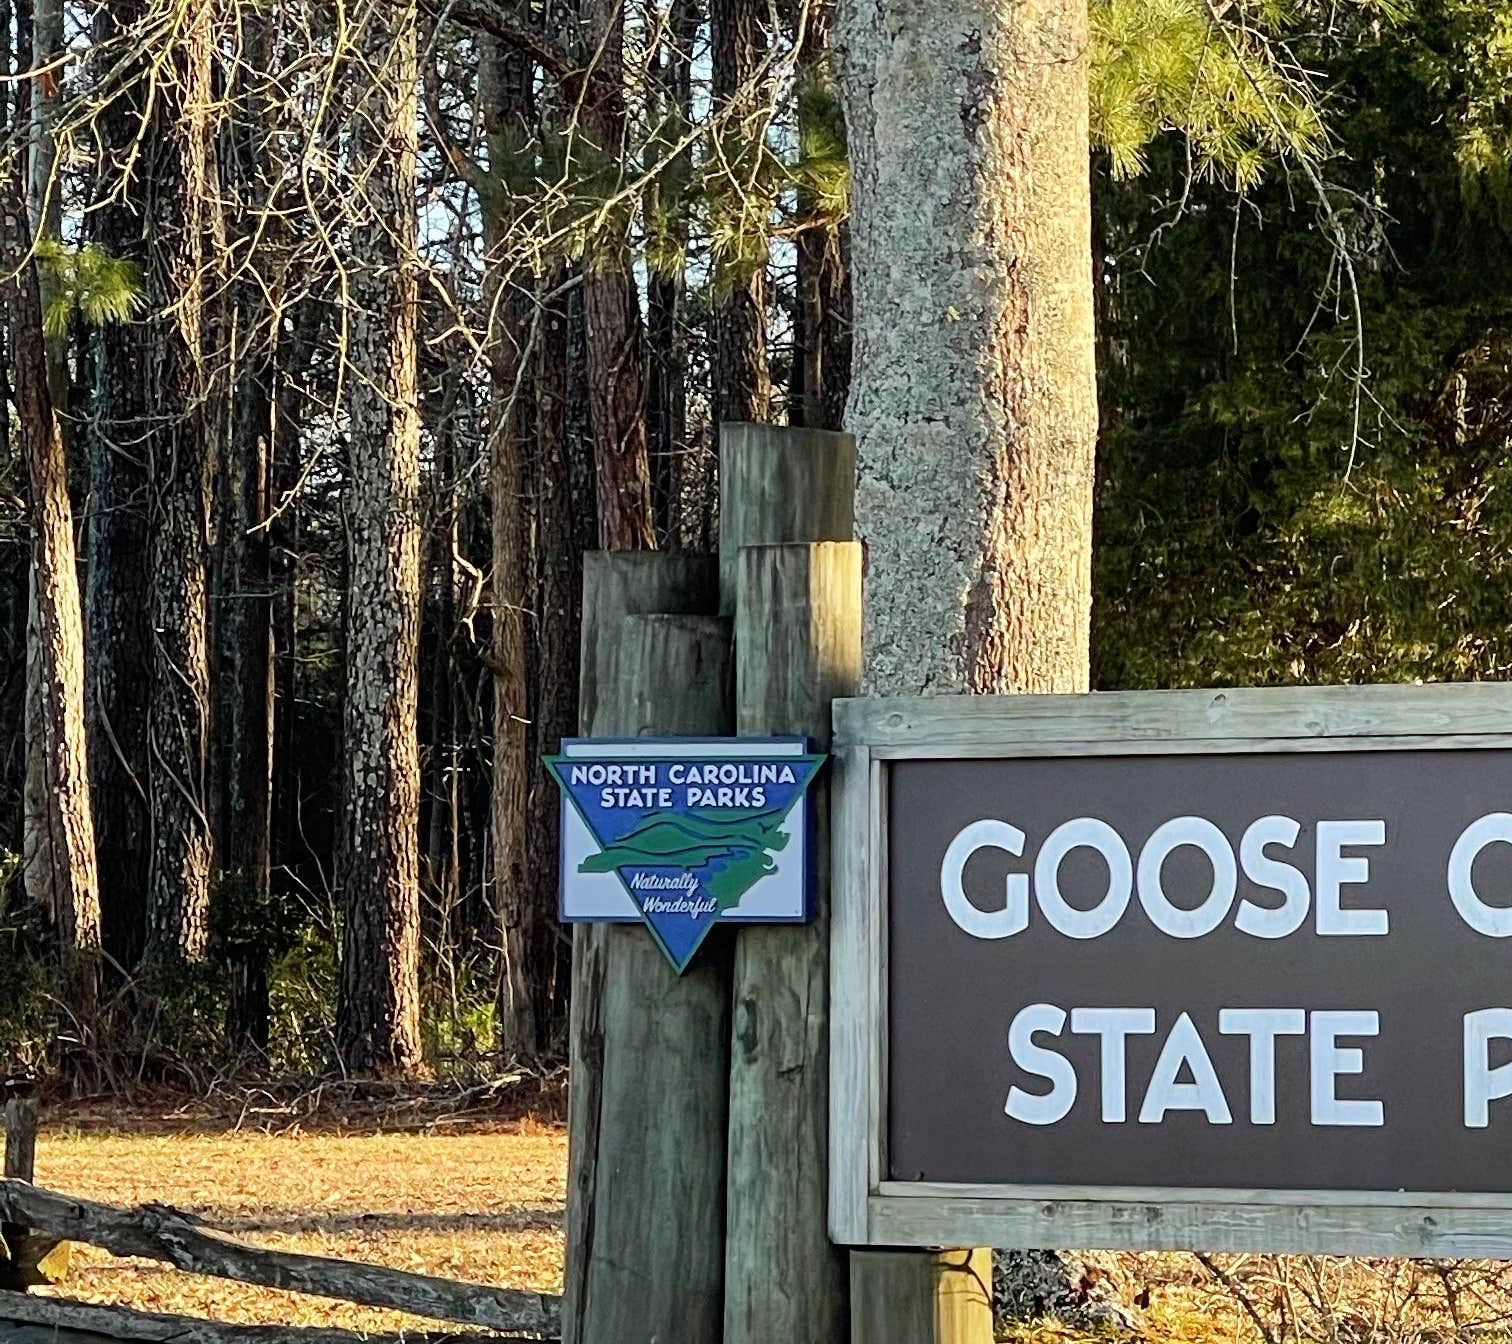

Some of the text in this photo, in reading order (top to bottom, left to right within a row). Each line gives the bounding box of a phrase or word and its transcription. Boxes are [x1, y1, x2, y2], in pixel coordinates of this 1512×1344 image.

[571, 764, 796, 785] NORTH CAROLINA
[600, 787, 766, 808] STATE PARKS
[630, 872, 699, 897] Naturally
[940, 815, 1389, 939] GOOSE
[643, 896, 718, 919] Wonderful
[1004, 1003, 1384, 1126] STATE
